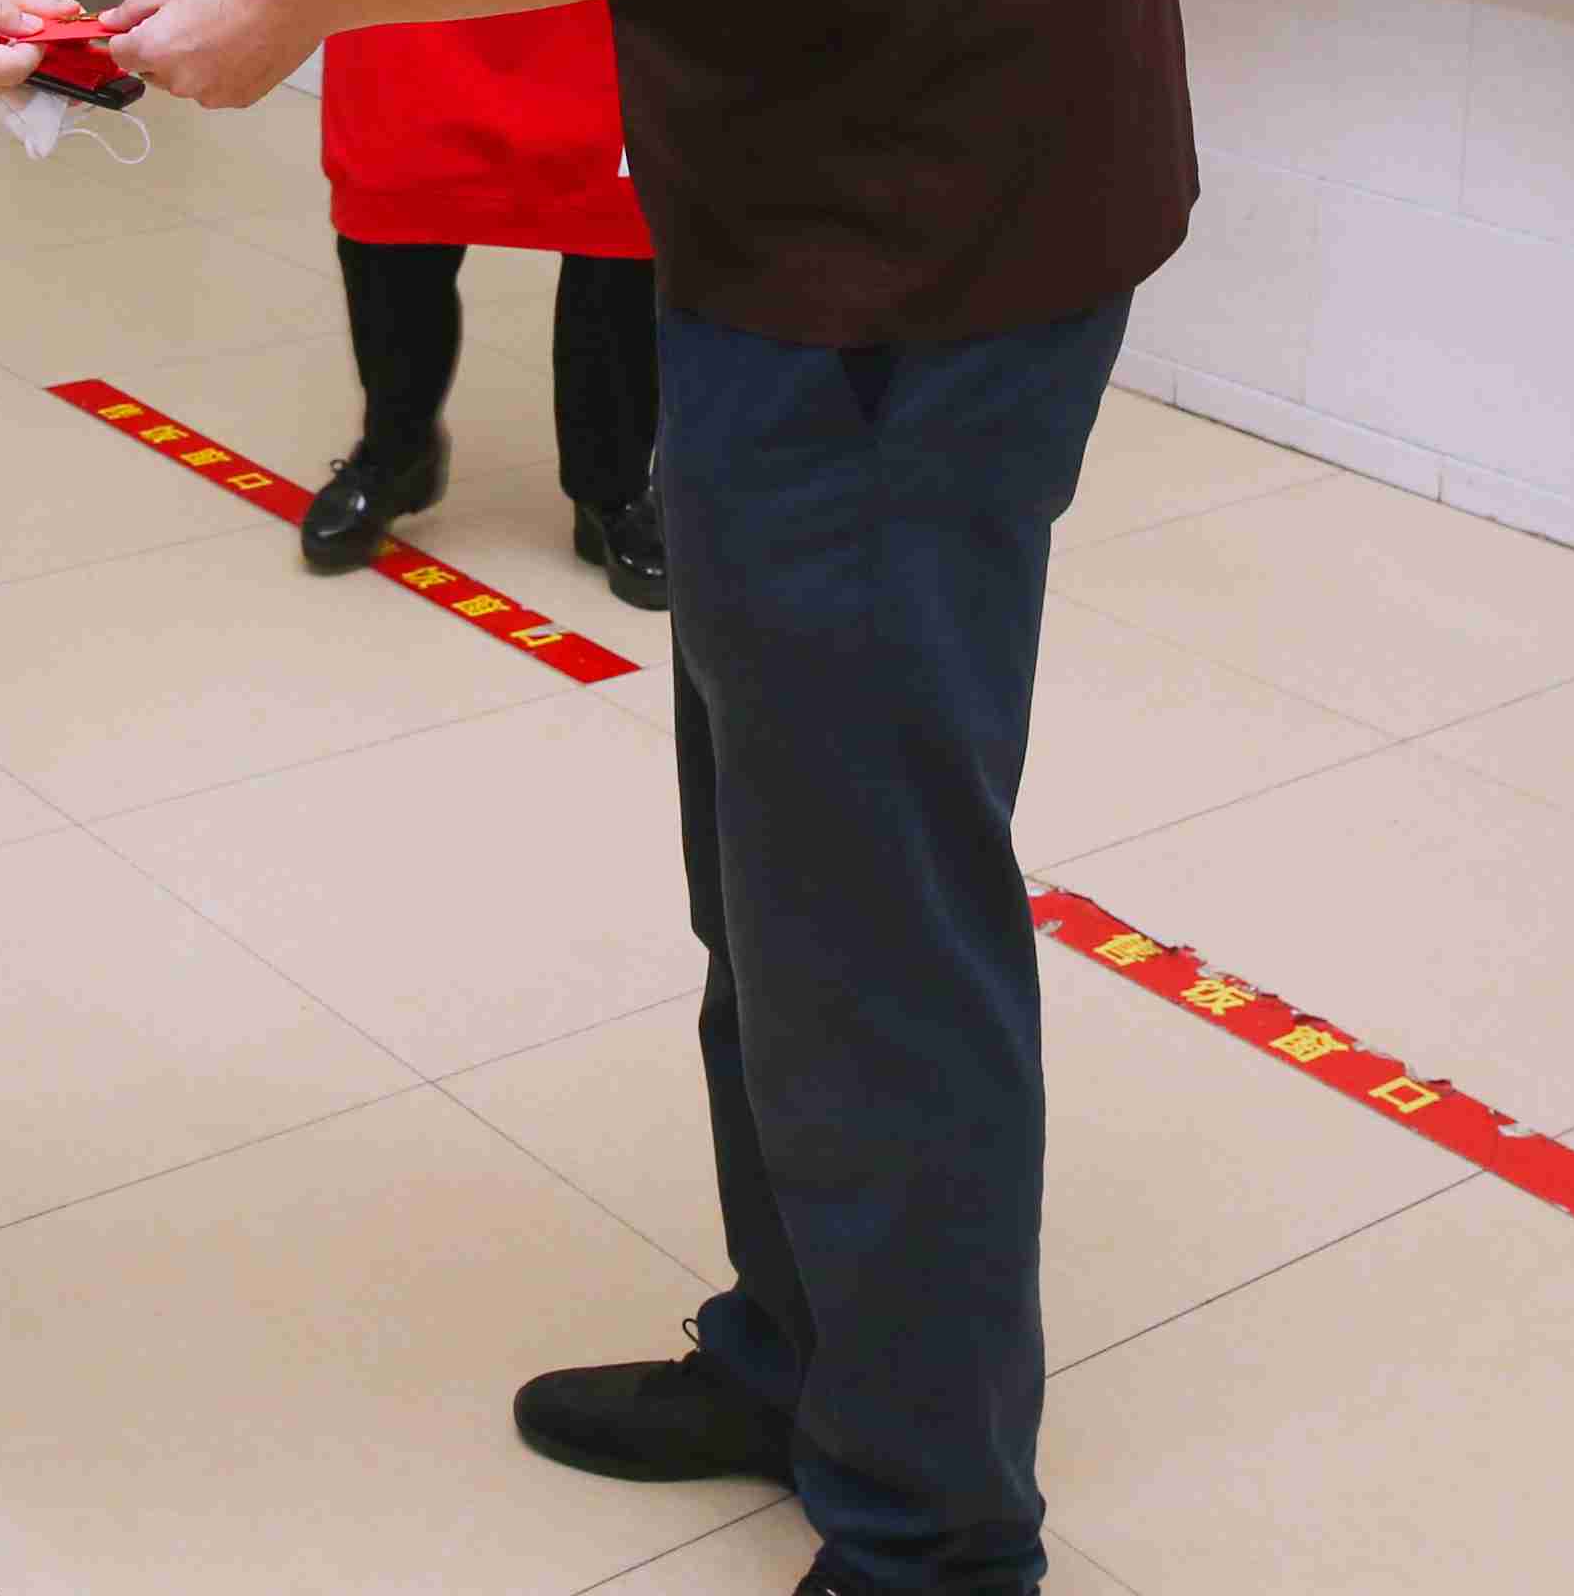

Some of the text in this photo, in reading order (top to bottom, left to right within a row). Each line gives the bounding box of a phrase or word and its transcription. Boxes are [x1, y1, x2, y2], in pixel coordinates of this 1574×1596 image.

[98, 402, 273, 490] 售饭窗口
[378, 535, 562, 647] 饭窗口
[1093, 932, 1441, 1114] 售饭窗口
